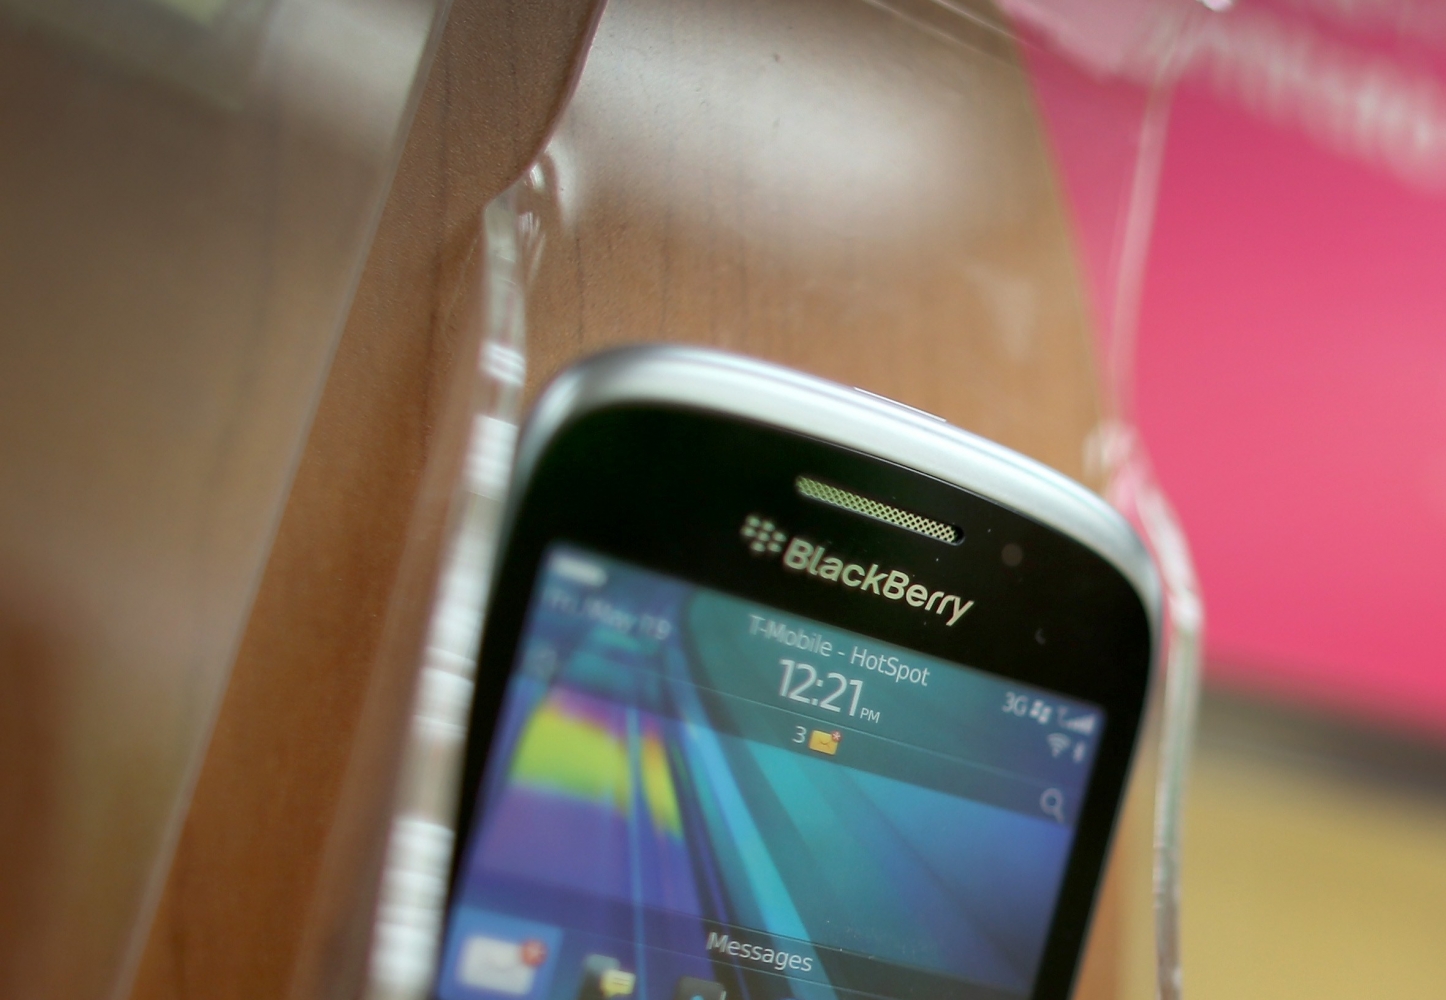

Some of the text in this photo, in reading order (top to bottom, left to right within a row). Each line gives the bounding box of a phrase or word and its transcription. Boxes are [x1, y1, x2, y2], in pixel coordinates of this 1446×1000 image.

[783, 537, 974, 627] BlackBerry
[749, 613, 833, 657] T-Mobile
[851, 646, 930, 687] HotSpot
[778, 658, 880, 723] 12:21 PM
[1001, 691, 1028, 717] 3G
[792, 725, 807, 743] 3
[706, 931, 813, 972] Messages
